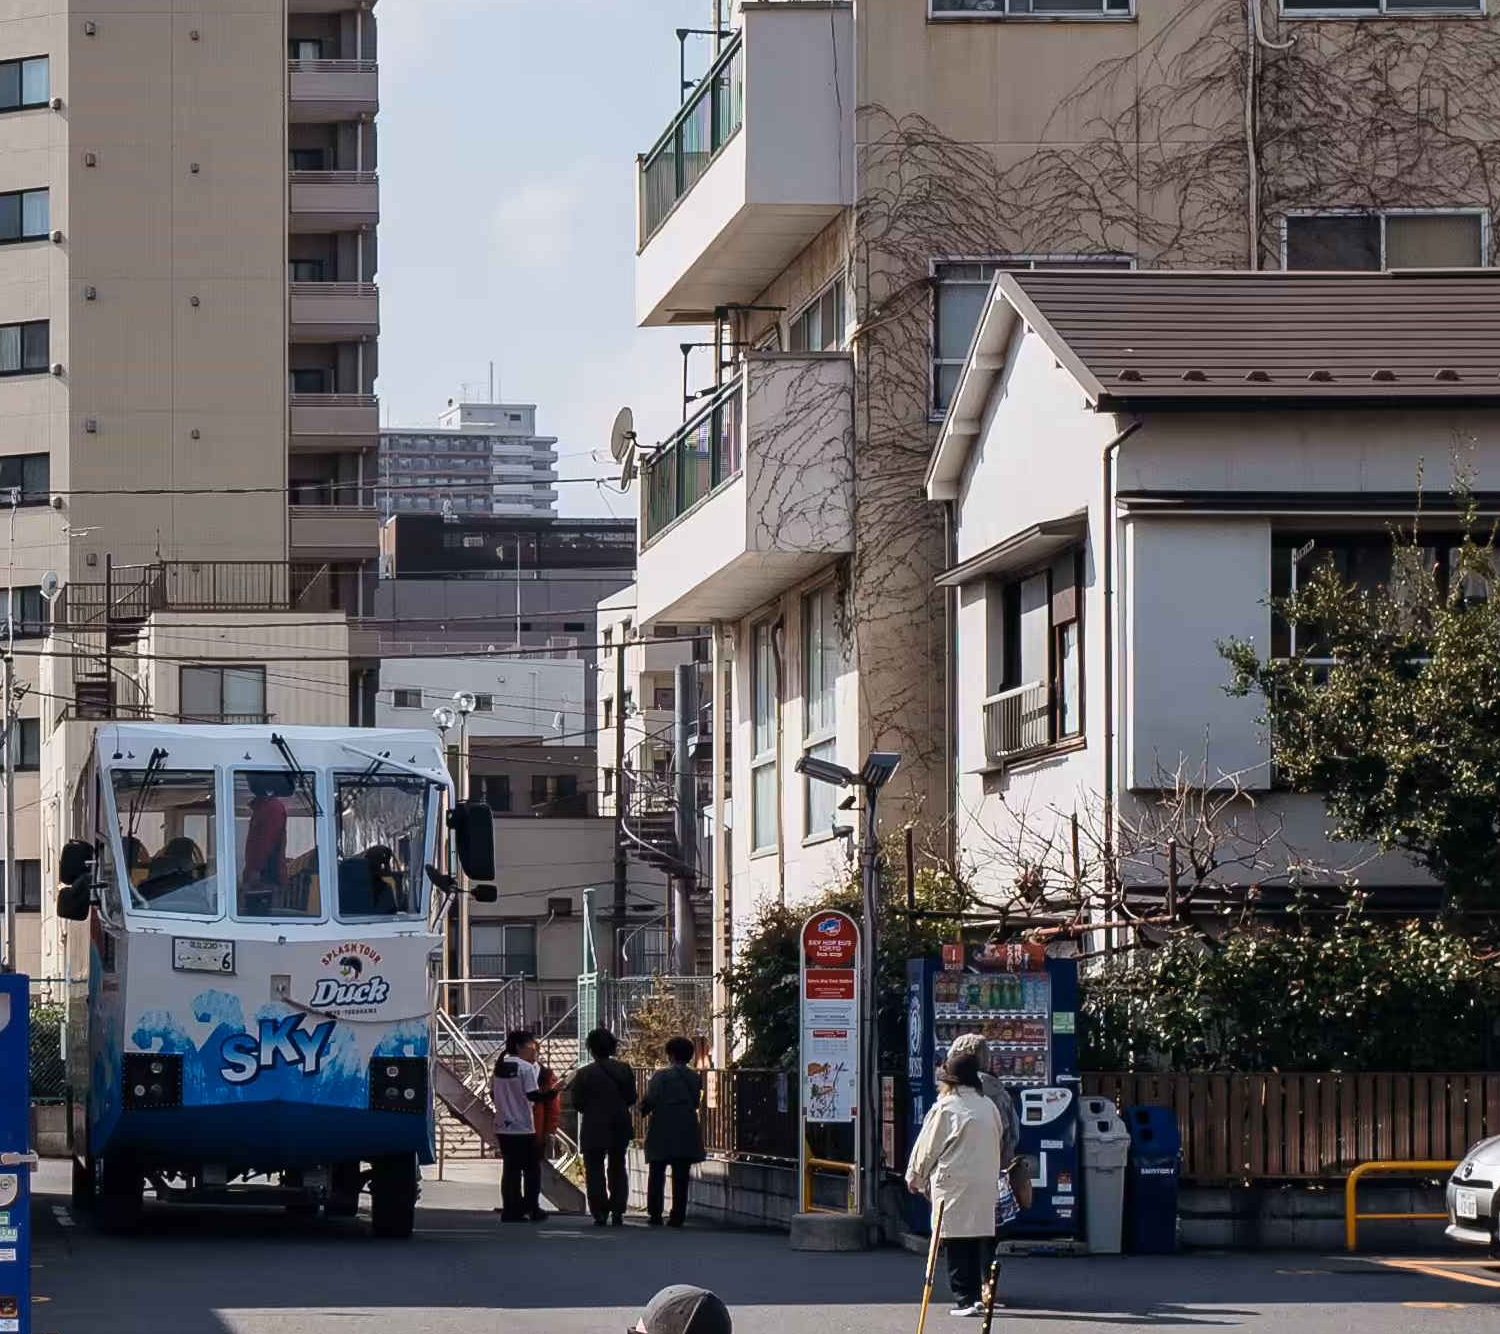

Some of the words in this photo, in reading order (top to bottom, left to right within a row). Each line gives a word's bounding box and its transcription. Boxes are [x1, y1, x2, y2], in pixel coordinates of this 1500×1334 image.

[321, 943, 358, 966] SPLASH
[358, 944, 382, 965] TOUR
[311, 975, 391, 1008] Duck
[220, 1012, 338, 1086] SKY
